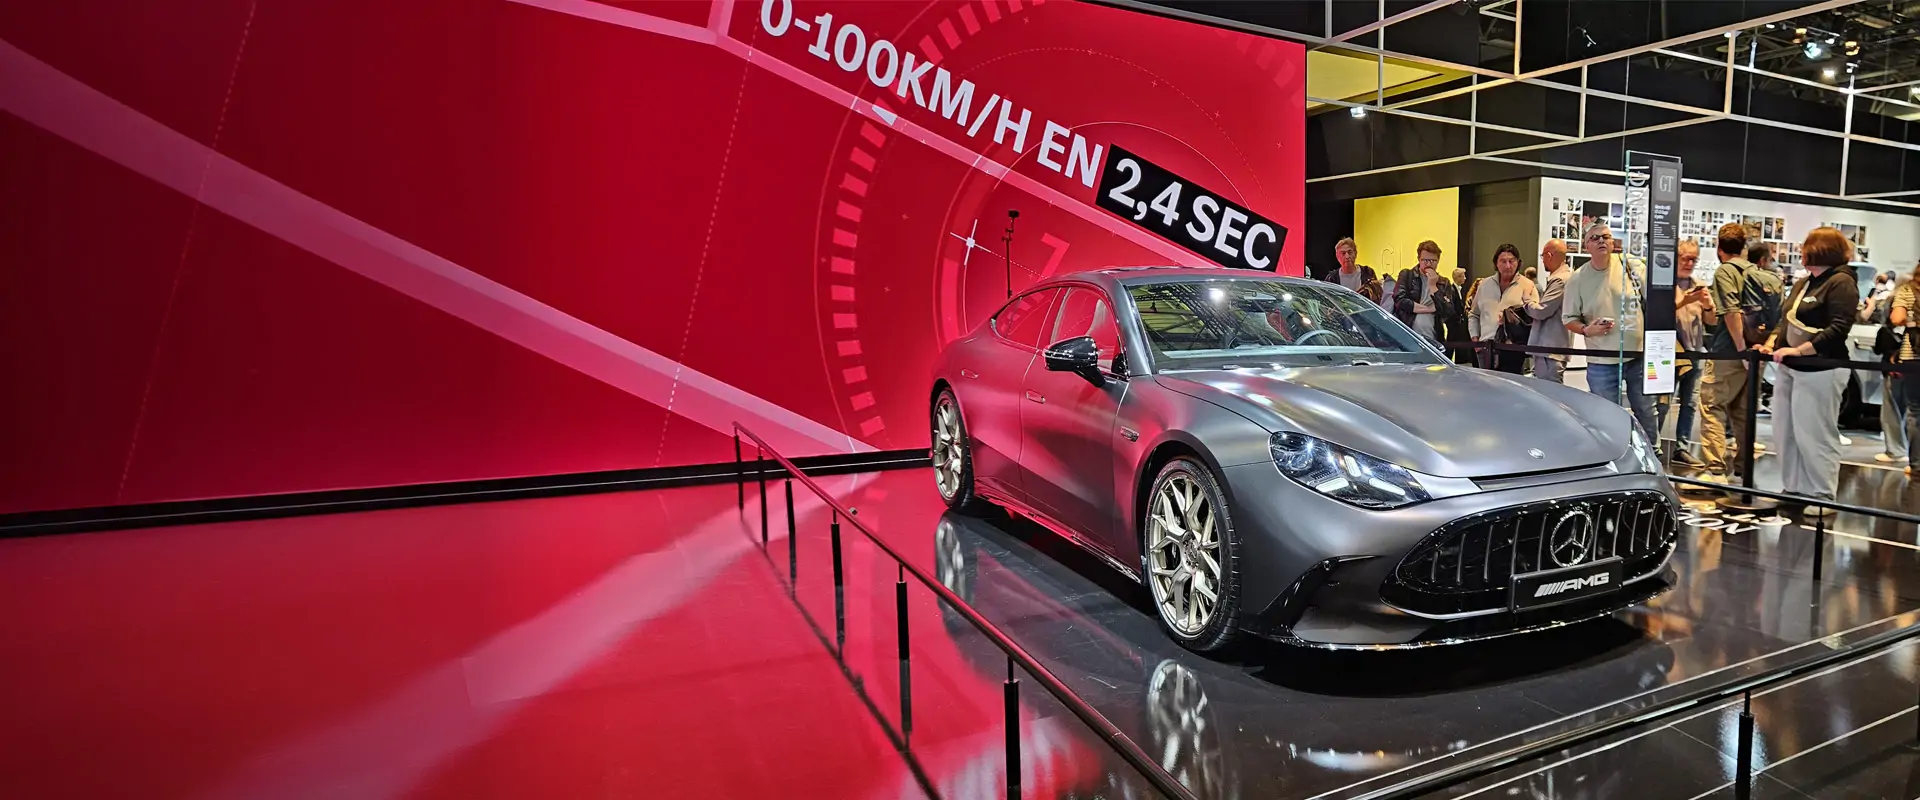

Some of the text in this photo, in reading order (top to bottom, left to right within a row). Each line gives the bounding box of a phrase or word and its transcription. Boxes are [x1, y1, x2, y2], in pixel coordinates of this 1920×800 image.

[761, 0, 1277, 269] 0-100KM/H EN 2,4 SEC
[1659, 174, 1675, 193] GT
[1558, 572, 1610, 593] AMG
